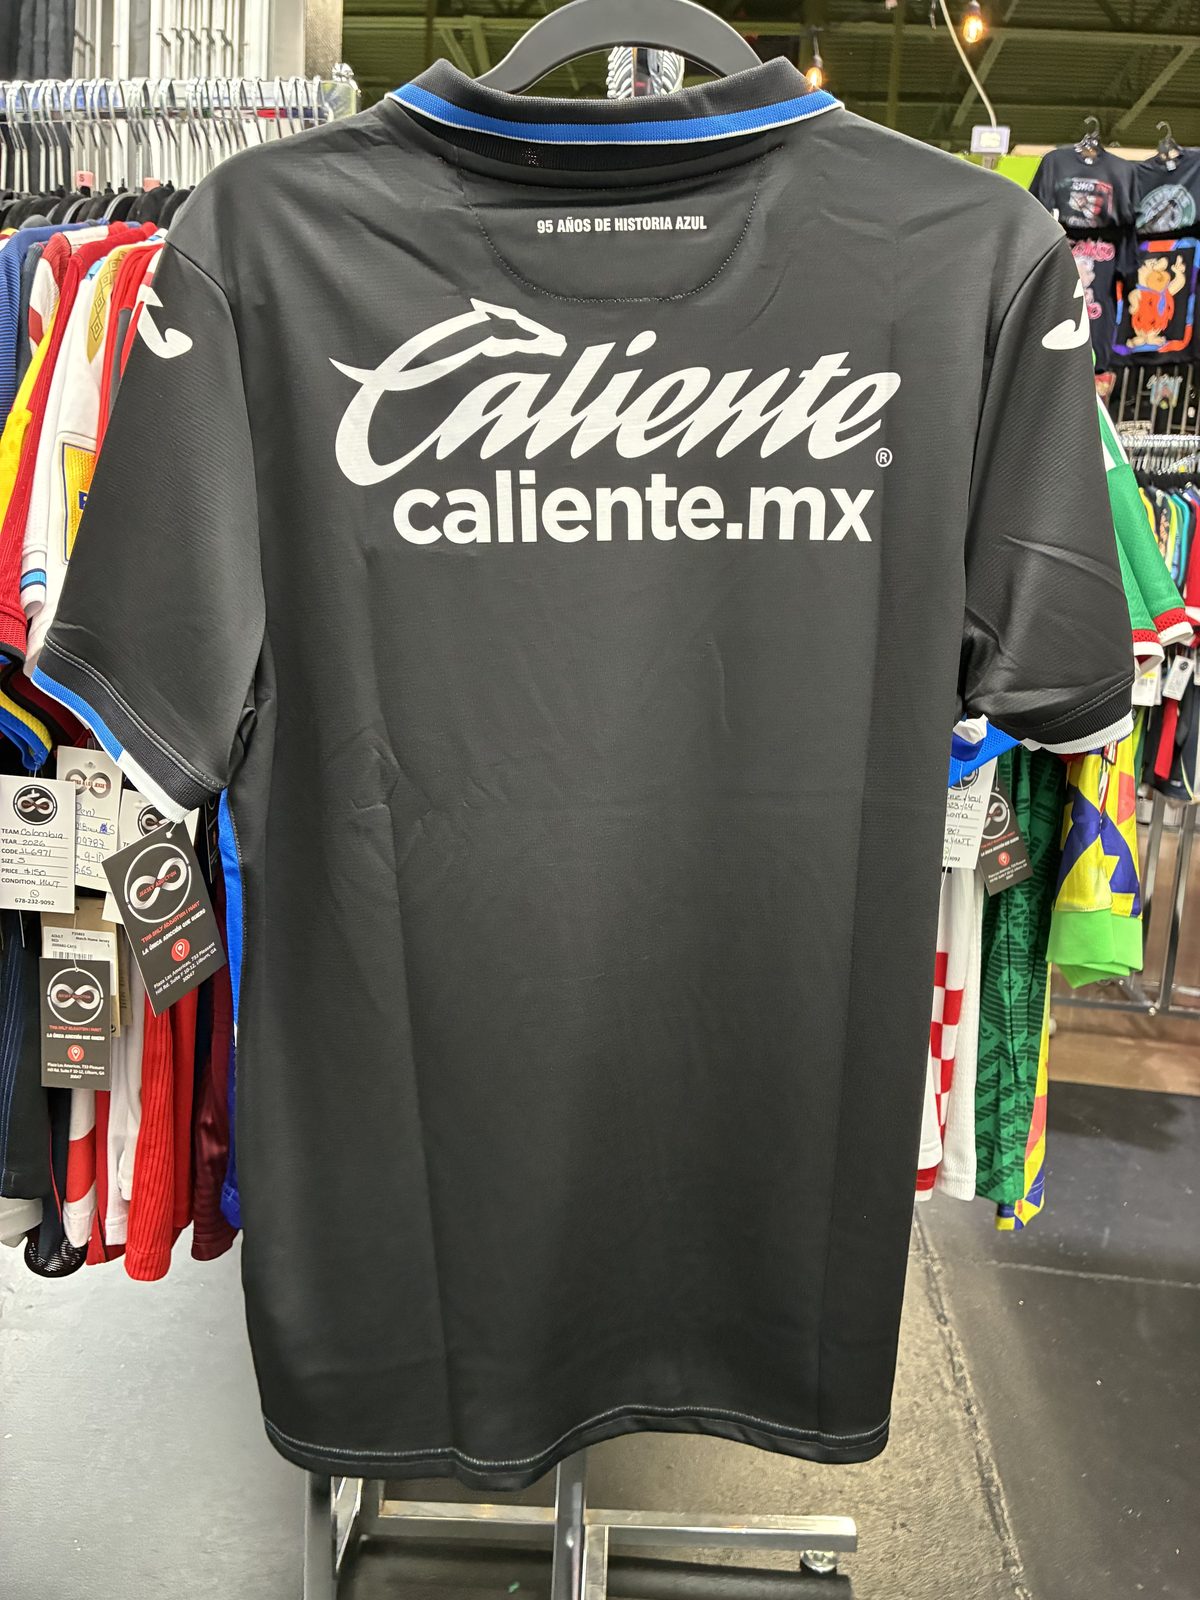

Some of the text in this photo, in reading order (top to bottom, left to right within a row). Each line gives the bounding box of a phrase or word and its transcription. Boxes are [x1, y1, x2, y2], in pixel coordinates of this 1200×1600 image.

[537, 215, 707, 233] 95 AÑOS DE HISTORIA AZUL
[328, 298, 902, 486] Caliente
[392, 468, 875, 545] caliente.mx
[20, 828, 63, 839] Colombia
[22, 839, 46, 847] 2026
[1, 878, 36, 886] CONDITION
